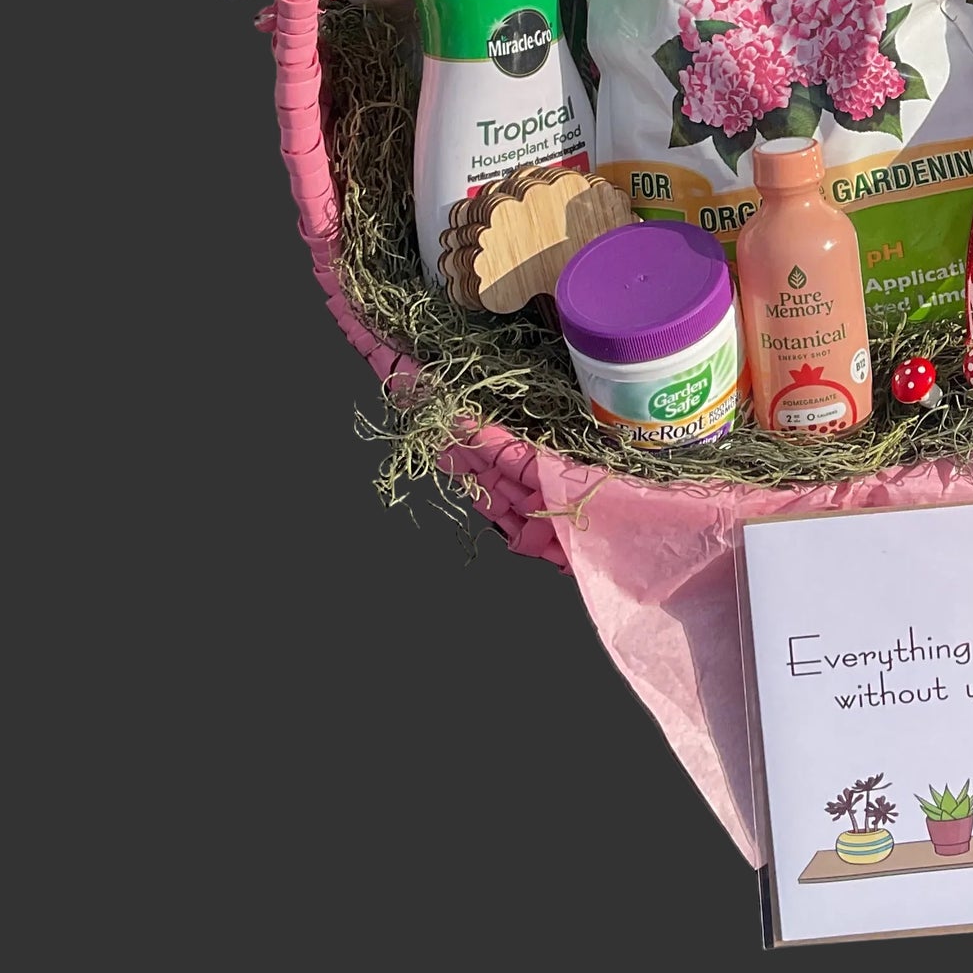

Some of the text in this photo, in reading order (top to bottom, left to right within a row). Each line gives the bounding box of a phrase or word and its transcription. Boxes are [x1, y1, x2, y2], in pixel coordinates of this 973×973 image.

[477, 96, 574, 146] Tropical
[472, 125, 581, 169] Houseplant Food
[631, 171, 673, 201] FOR
[866, 240, 904, 269] pH
[865, 259, 965, 295] Applicati
[766, 299, 834, 318] Memory
[779, 291, 823, 307] Pure
[761, 323, 848, 351] Botanical
[778, 349, 832, 362] ENERGY SHOT
[653, 378, 708, 409] Garden
[665, 393, 700, 418] Safe
[782, 393, 838, 407] POMEGRANATE
[786, 414, 793, 423] 2
[786, 626, 972, 677] Everything
[834, 672, 949, 709] without
